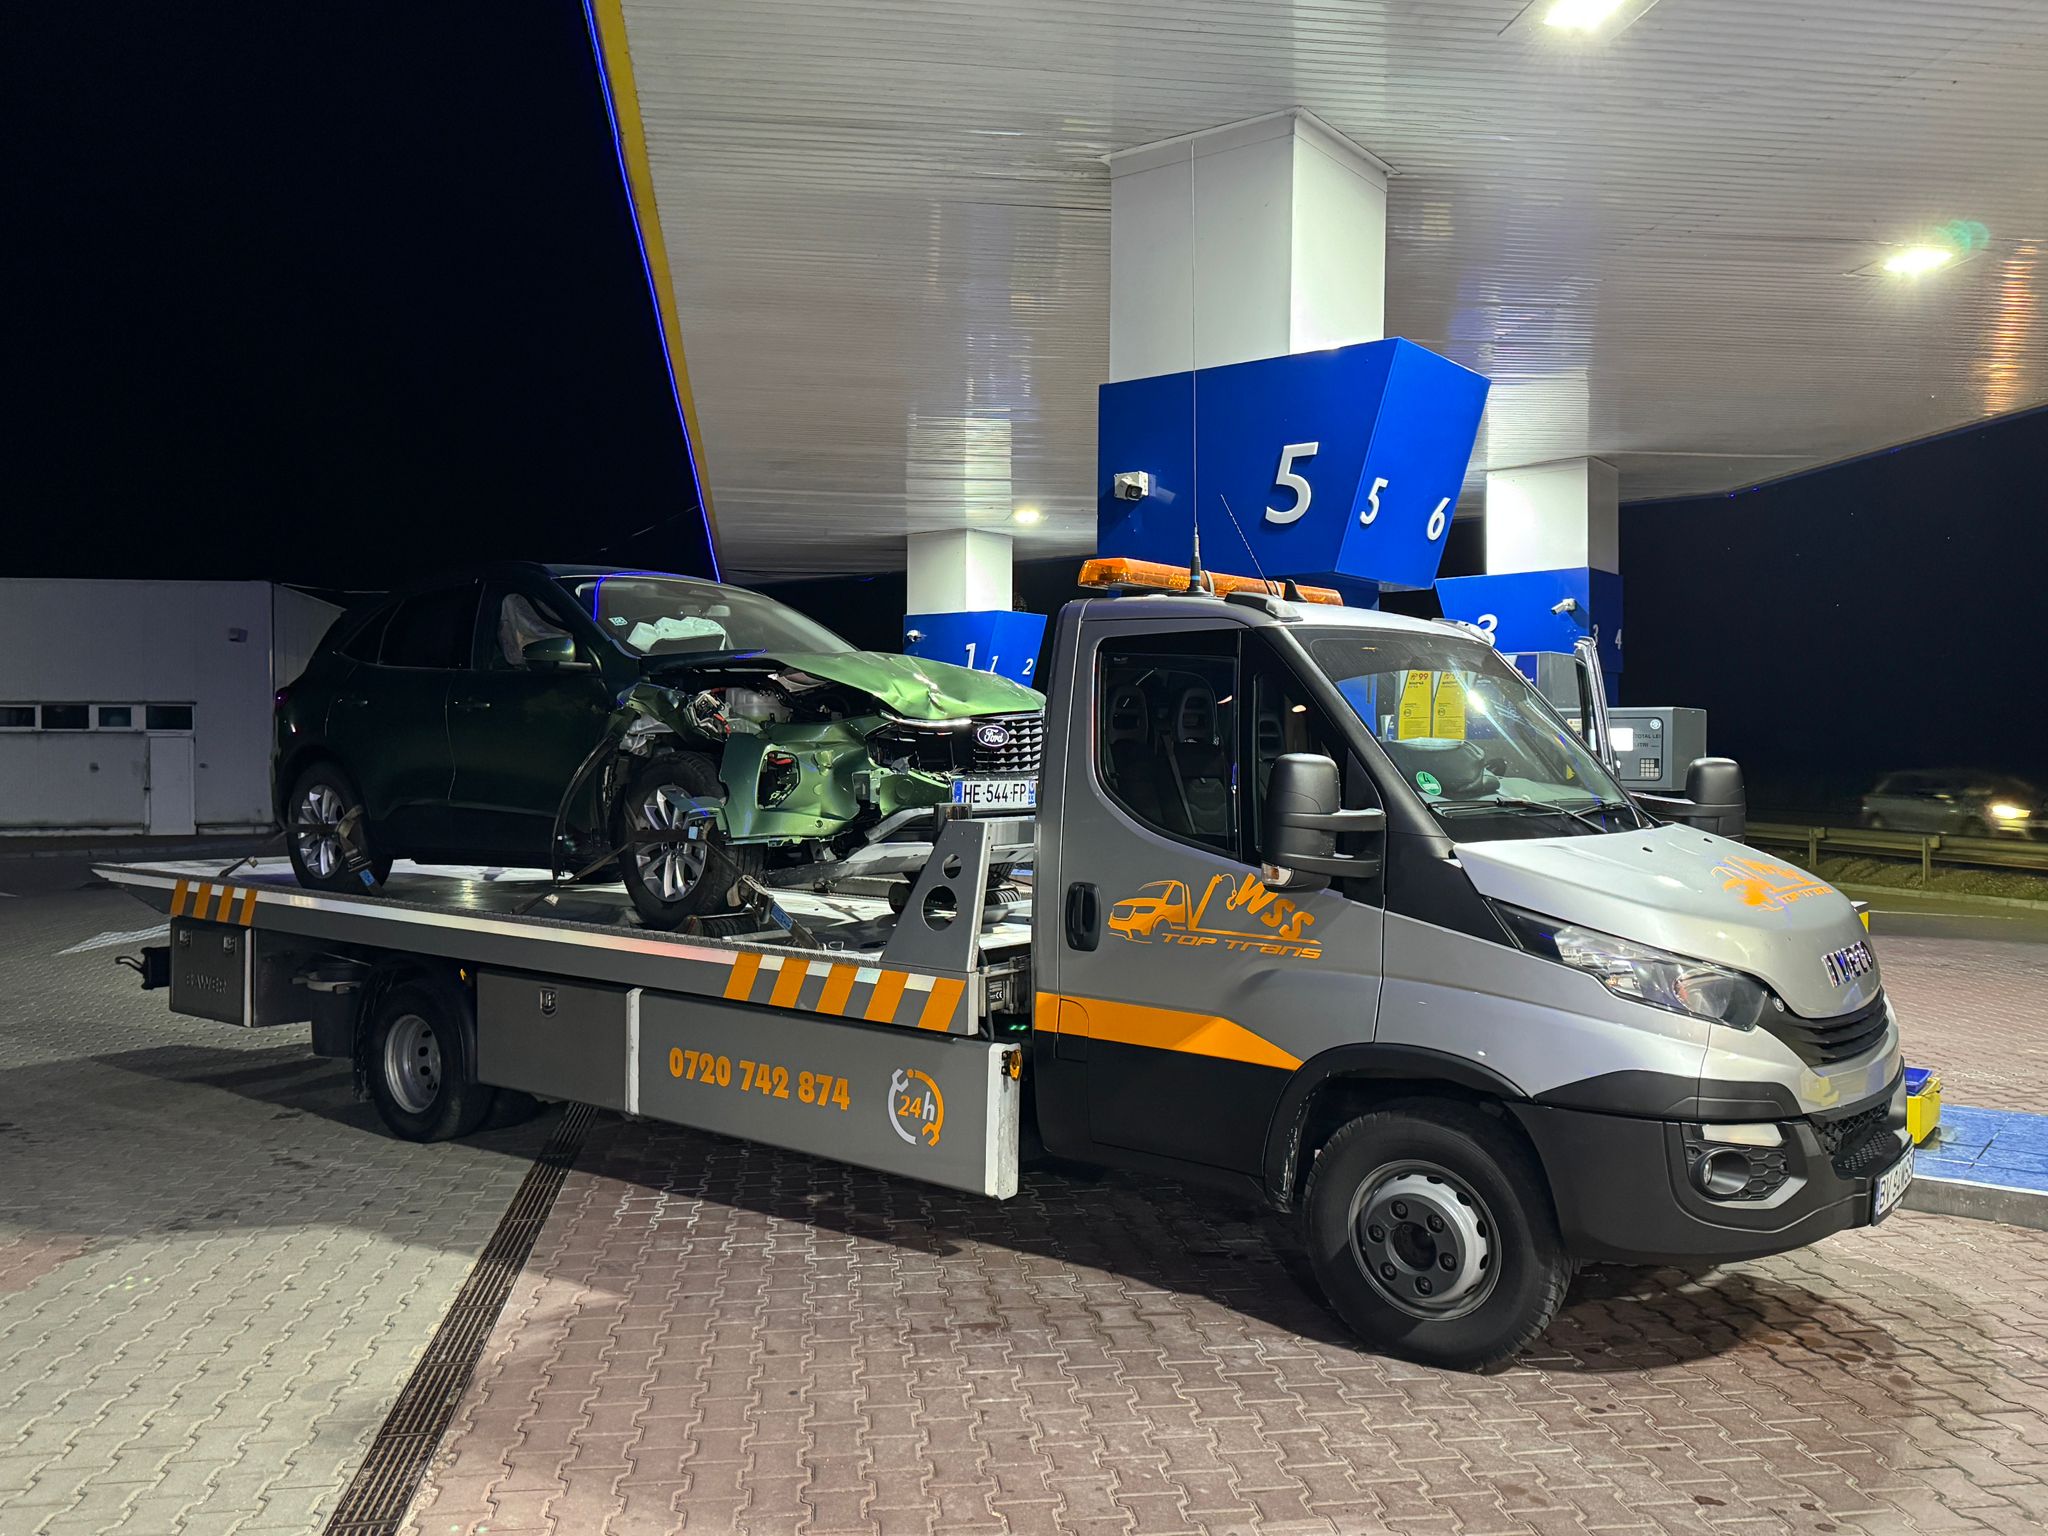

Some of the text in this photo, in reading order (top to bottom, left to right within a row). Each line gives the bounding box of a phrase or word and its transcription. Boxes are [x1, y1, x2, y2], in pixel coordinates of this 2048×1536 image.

[1264, 441, 1319, 524] 5
[1359, 476, 1451, 541] 5 6
[1477, 614, 1498, 647] 3
[1615, 629, 1622, 650] 4
[965, 642, 977, 669] 1
[989, 655, 1034, 675] 1 2
[983, 728, 1004, 743] Ford
[1234, 872, 1315, 938] WSS
[1160, 932, 1218, 946] TOP
[1821, 940, 1873, 988] IVECO
[668, 1047, 850, 1111] 0720 742 874
[897, 1091, 936, 1122] 24h
